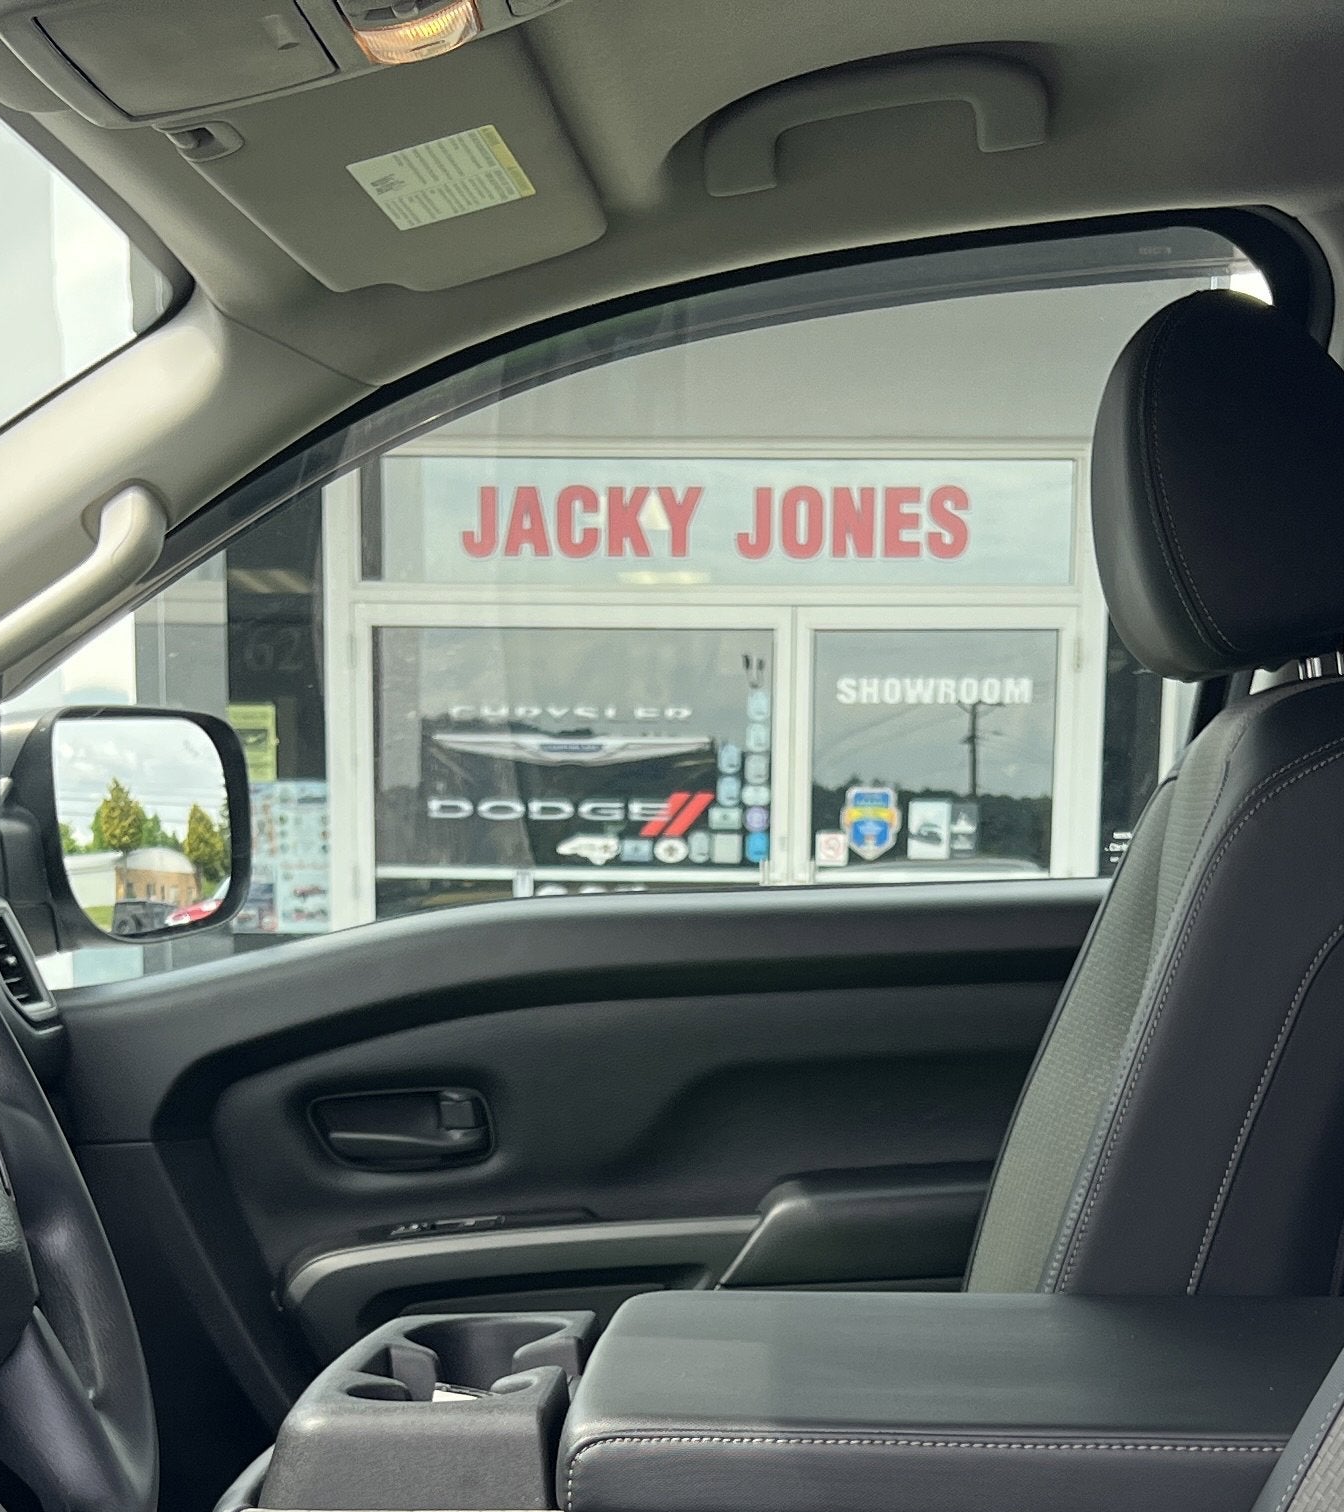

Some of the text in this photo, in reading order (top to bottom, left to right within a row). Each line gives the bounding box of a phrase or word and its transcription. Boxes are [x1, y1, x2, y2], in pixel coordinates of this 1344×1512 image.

[461, 484, 971, 559] JACKY JONES
[835, 677, 1034, 705] SHOWROOM
[427, 798, 672, 821] DODGE
